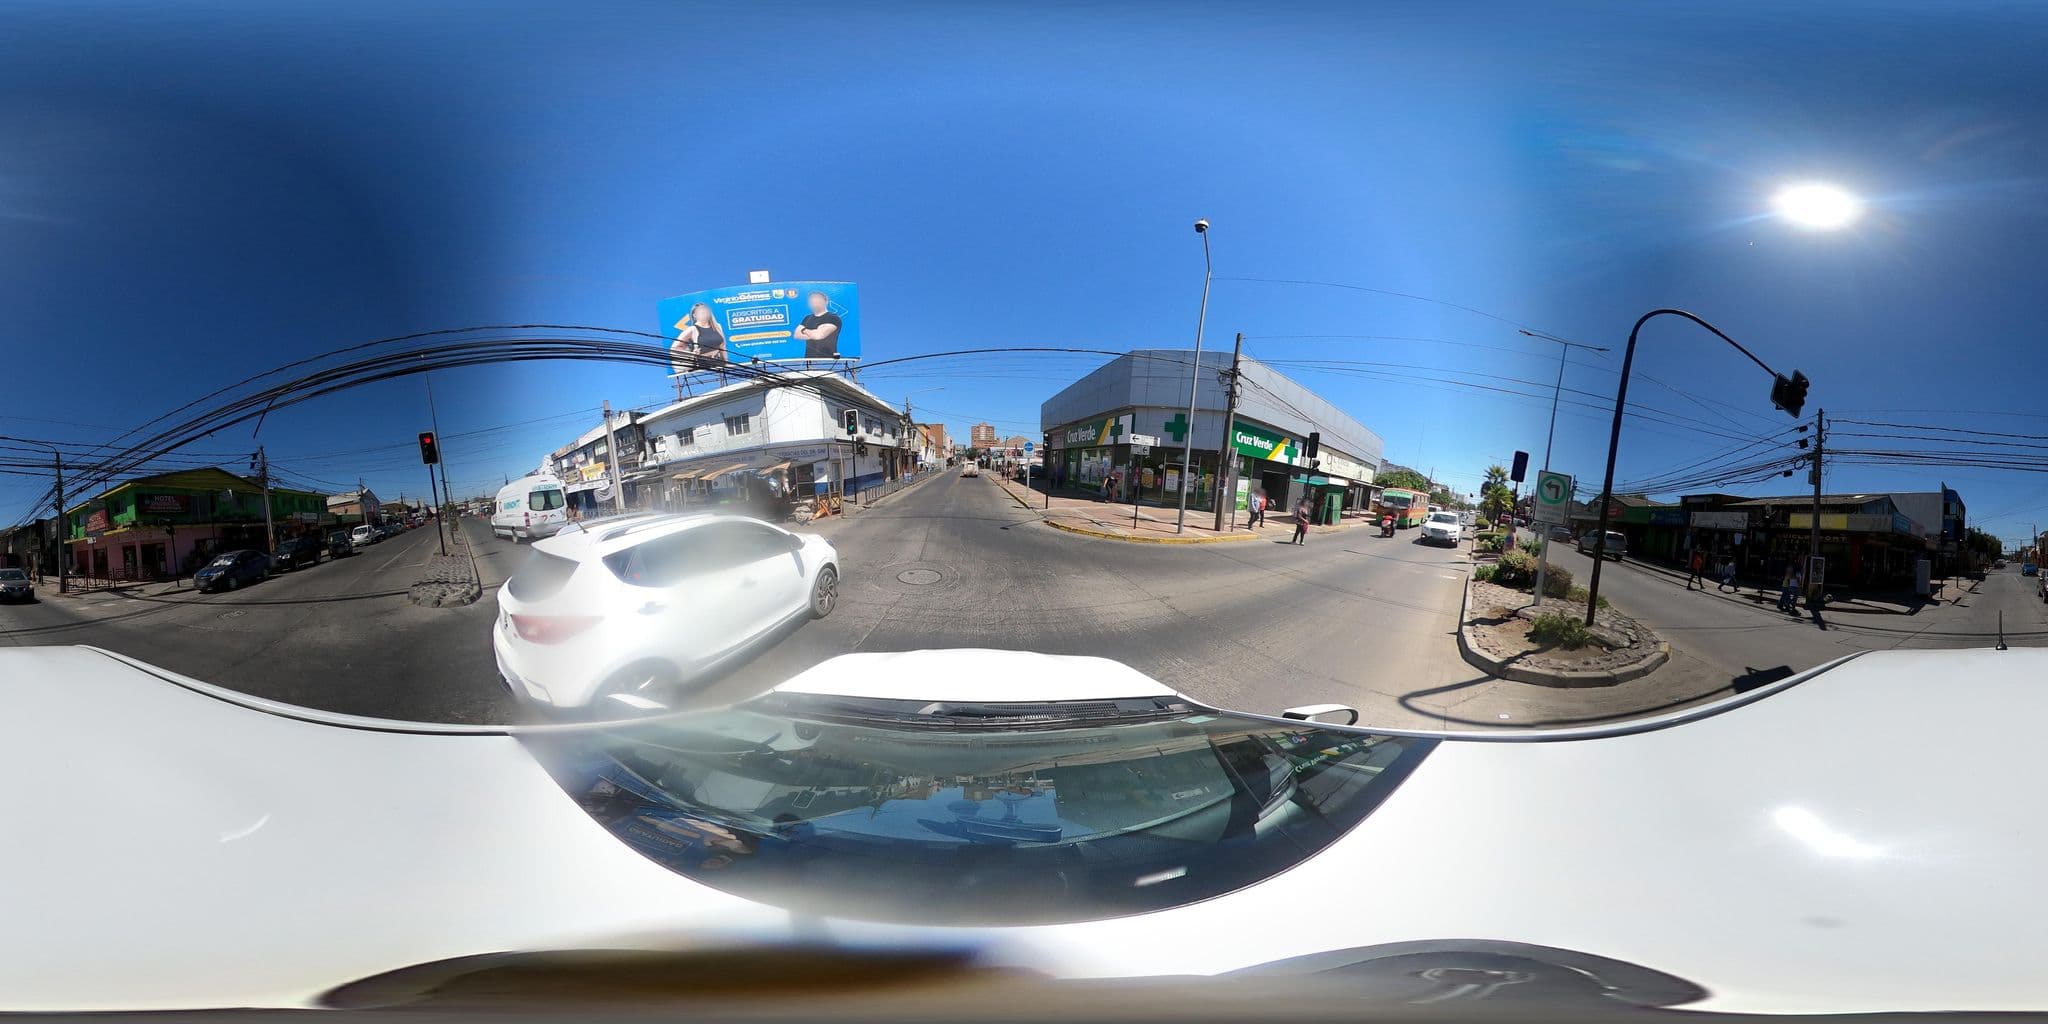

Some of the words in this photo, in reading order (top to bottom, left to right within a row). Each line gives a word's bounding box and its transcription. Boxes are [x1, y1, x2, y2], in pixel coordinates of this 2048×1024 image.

[732, 308, 773, 317] ADSCRITOS
[732, 313, 784, 323] GRATUIDAD
[1067, 430, 1078, 443] Cruz
[1078, 425, 1096, 442] Verde
[1236, 431, 1253, 445] Cruz
[1253, 435, 1273, 450] Verde
